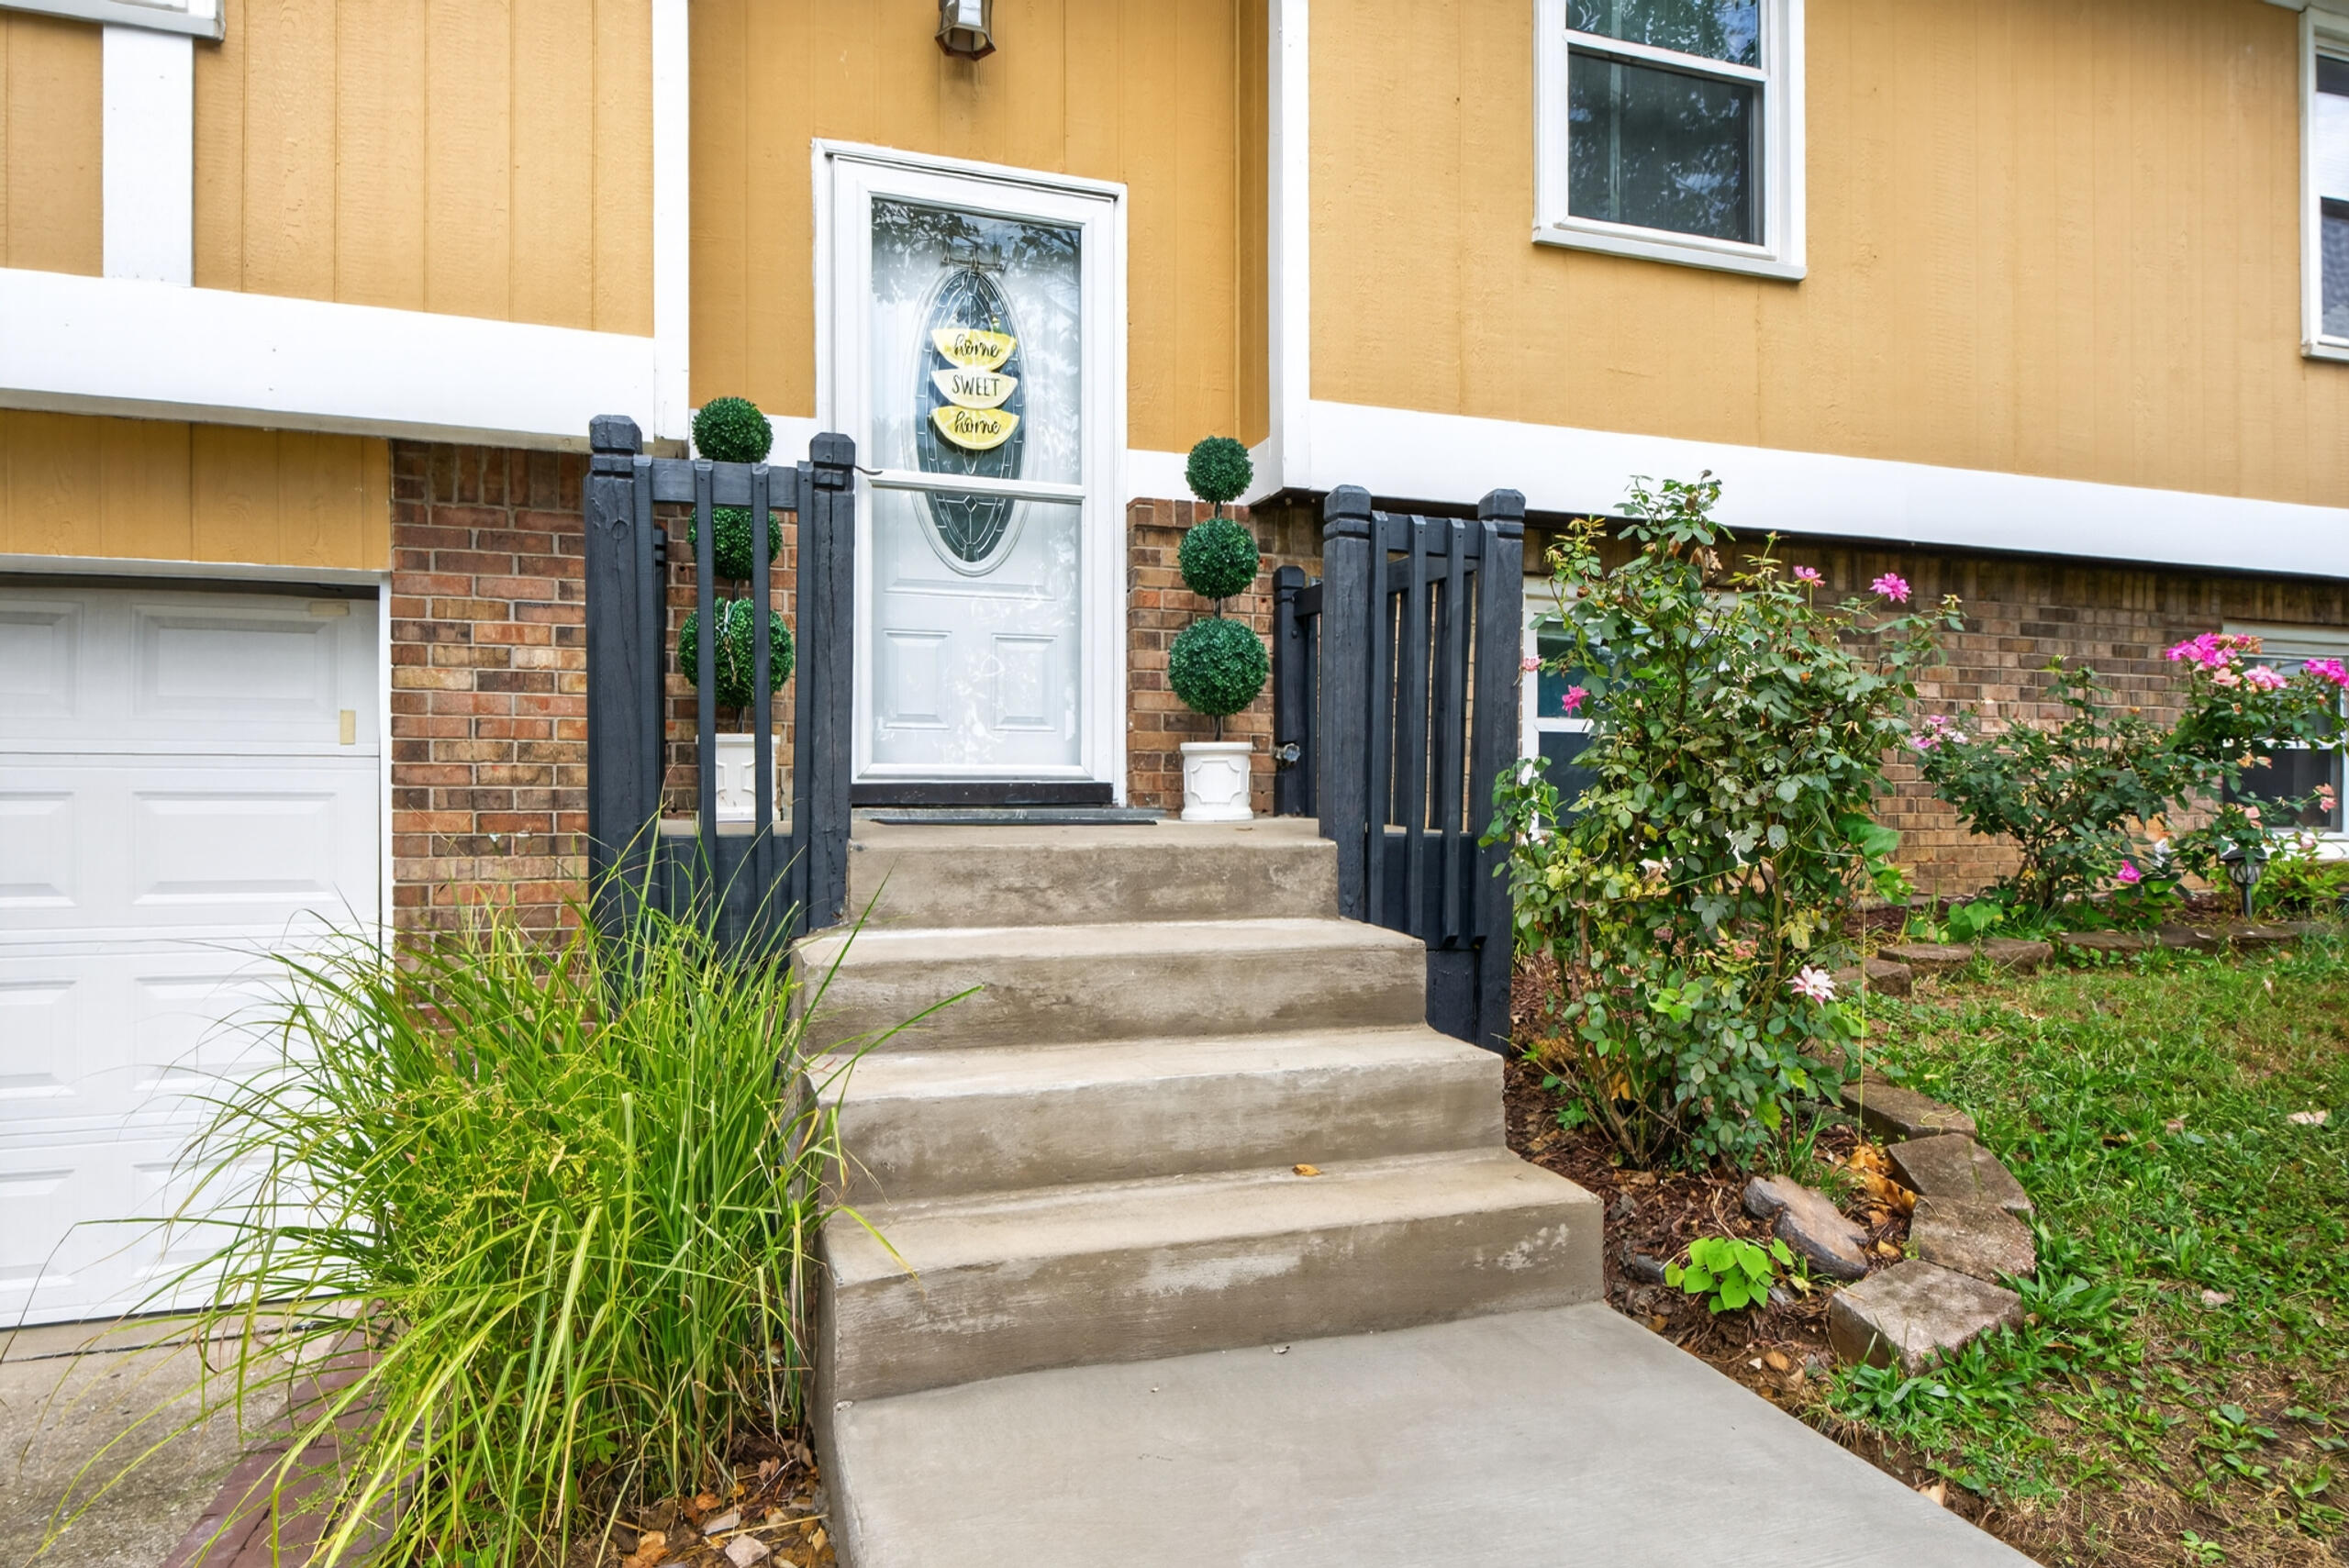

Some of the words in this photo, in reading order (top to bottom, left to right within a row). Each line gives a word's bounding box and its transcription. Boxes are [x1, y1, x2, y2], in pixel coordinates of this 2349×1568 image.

[954, 333, 1001, 358] home
[952, 374, 1000, 396] SWEET
[954, 410, 1002, 435] home
